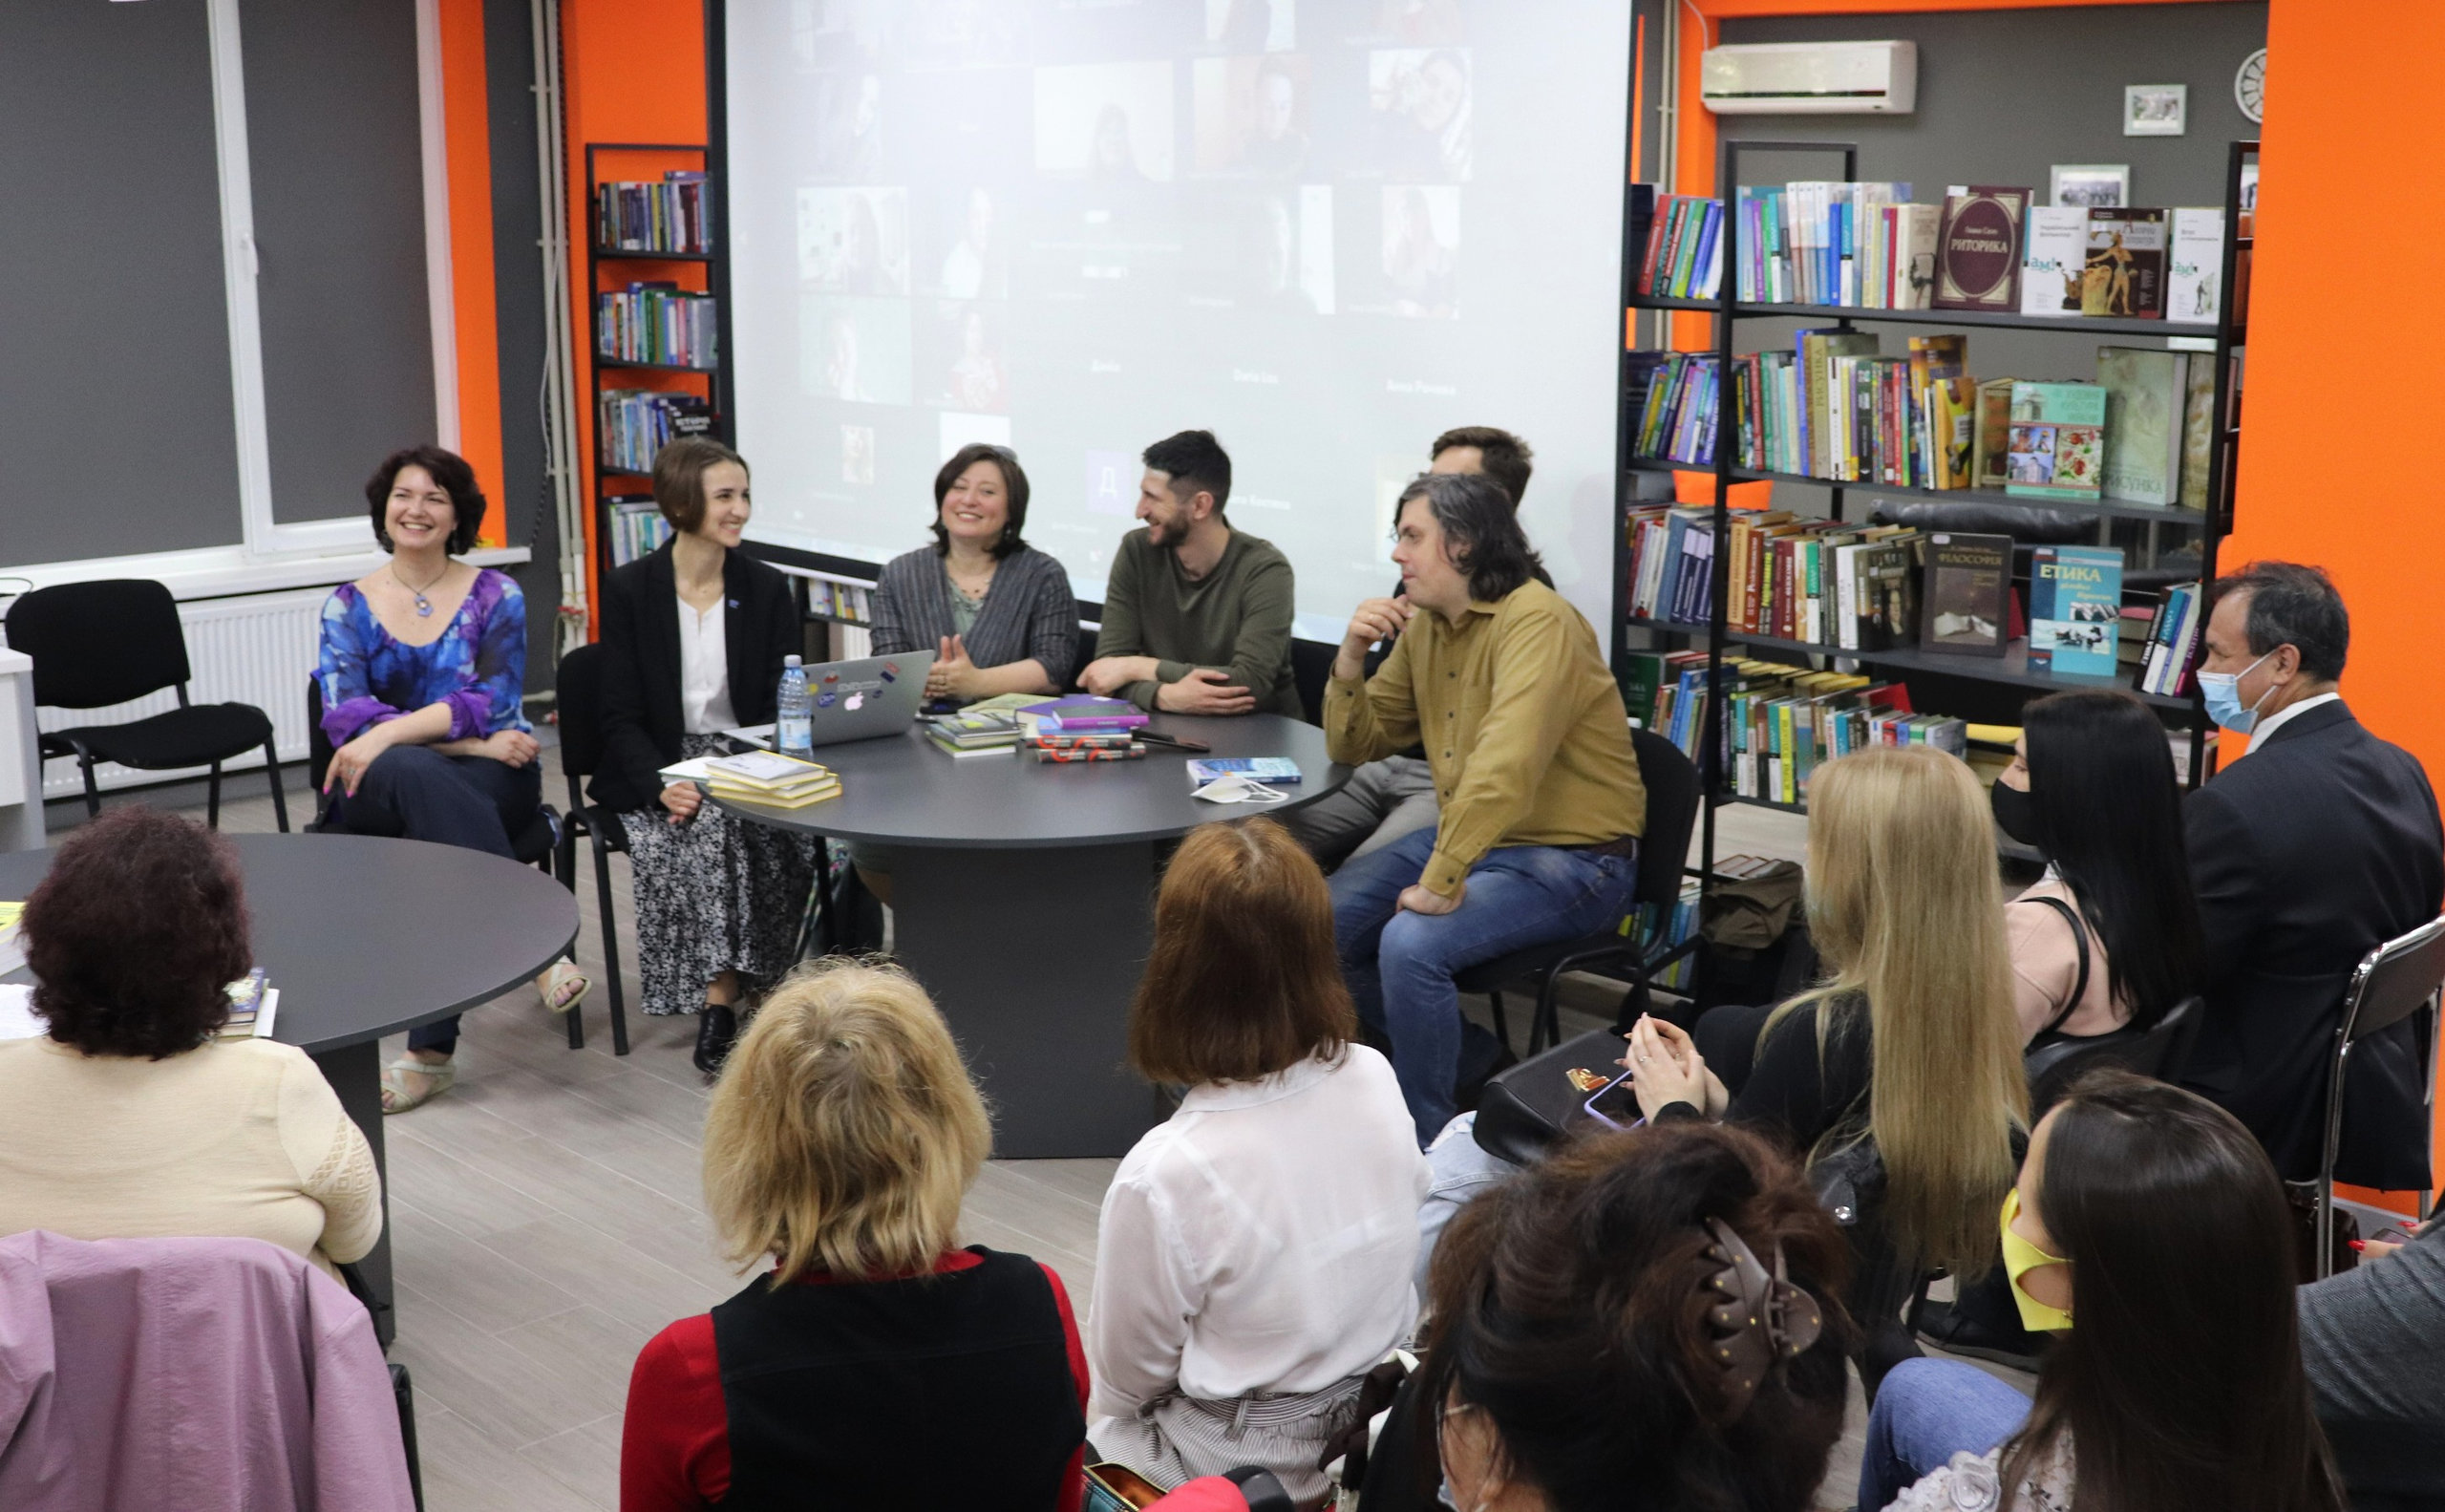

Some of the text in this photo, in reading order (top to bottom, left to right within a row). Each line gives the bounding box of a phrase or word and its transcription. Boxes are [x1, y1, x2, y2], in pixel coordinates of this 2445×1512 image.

[1950, 239, 2009, 253] РИТОРИКА
[1098, 467, 1116, 499] Д
[2039, 564, 2102, 582] ЕТИКА
